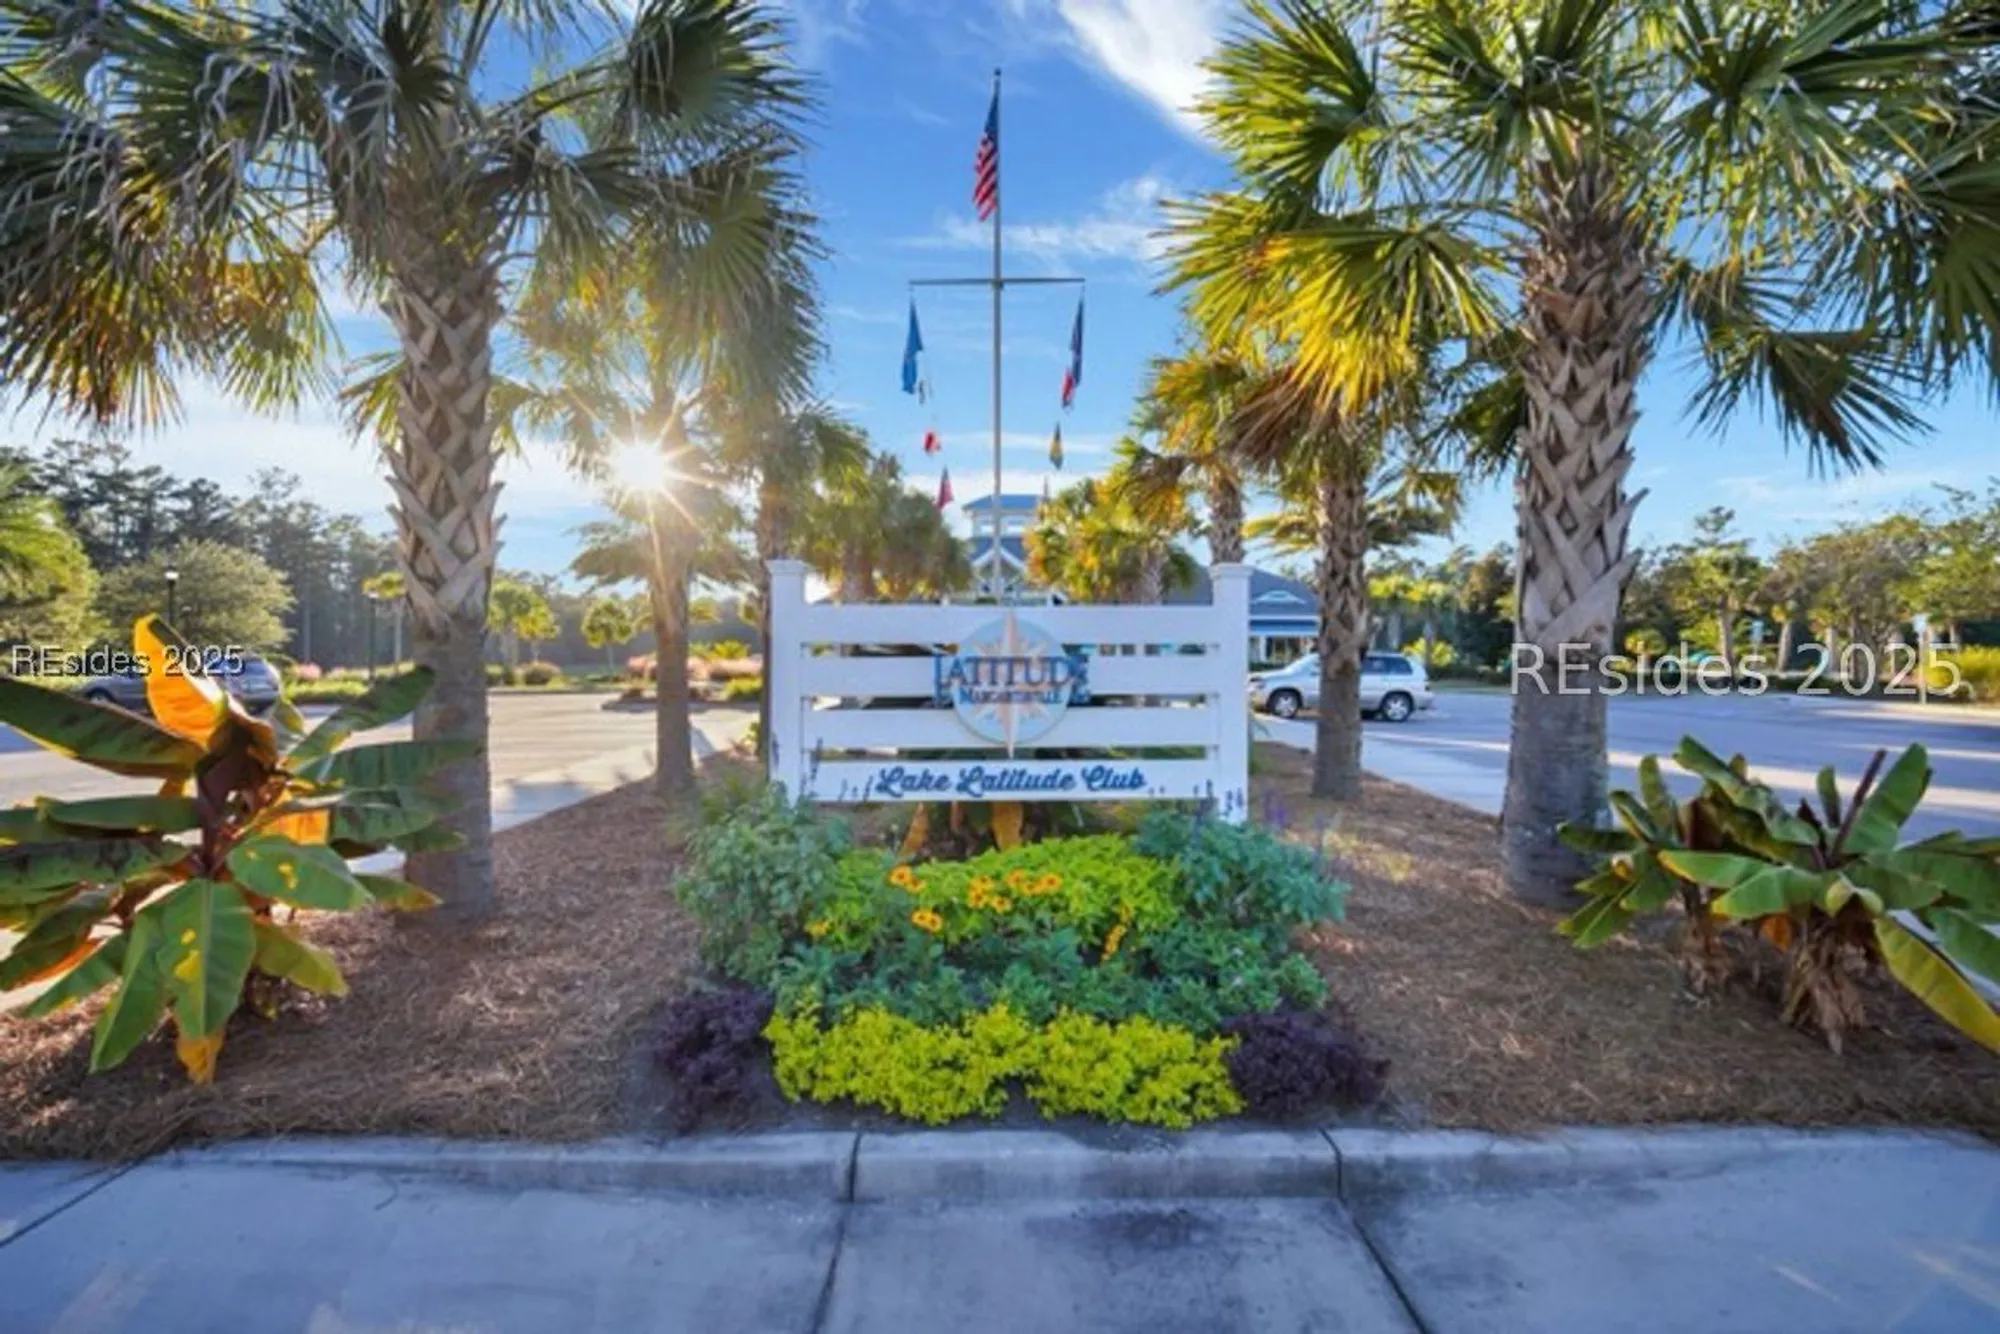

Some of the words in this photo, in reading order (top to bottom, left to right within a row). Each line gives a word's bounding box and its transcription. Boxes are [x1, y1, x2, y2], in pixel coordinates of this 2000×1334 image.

[874, 767, 952, 797] Lake
[956, 767, 1076, 797] Latitude
[1080, 765, 1147, 793] Club
